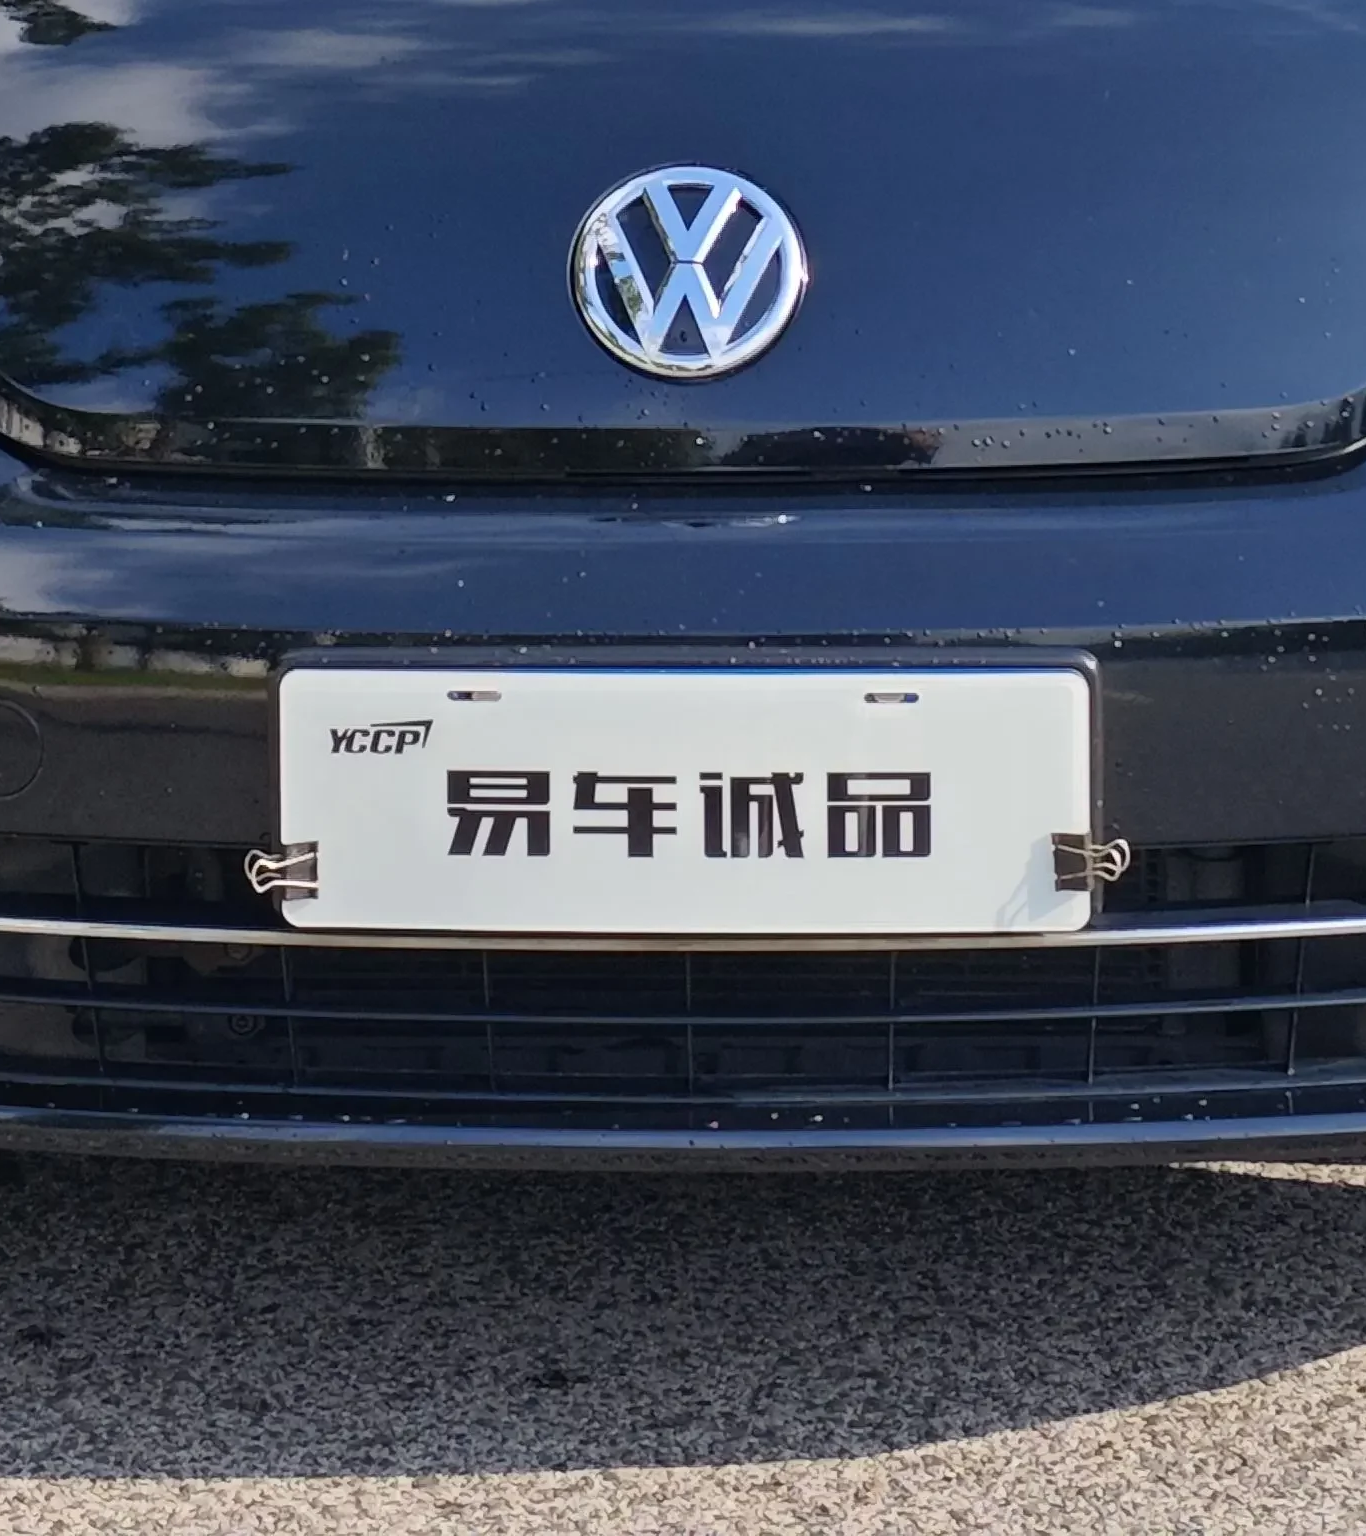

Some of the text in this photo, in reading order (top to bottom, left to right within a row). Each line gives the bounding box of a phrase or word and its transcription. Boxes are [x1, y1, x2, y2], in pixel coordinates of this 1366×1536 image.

[329, 727, 422, 754] YCCP
[446, 769, 933, 859] 易车诚品
